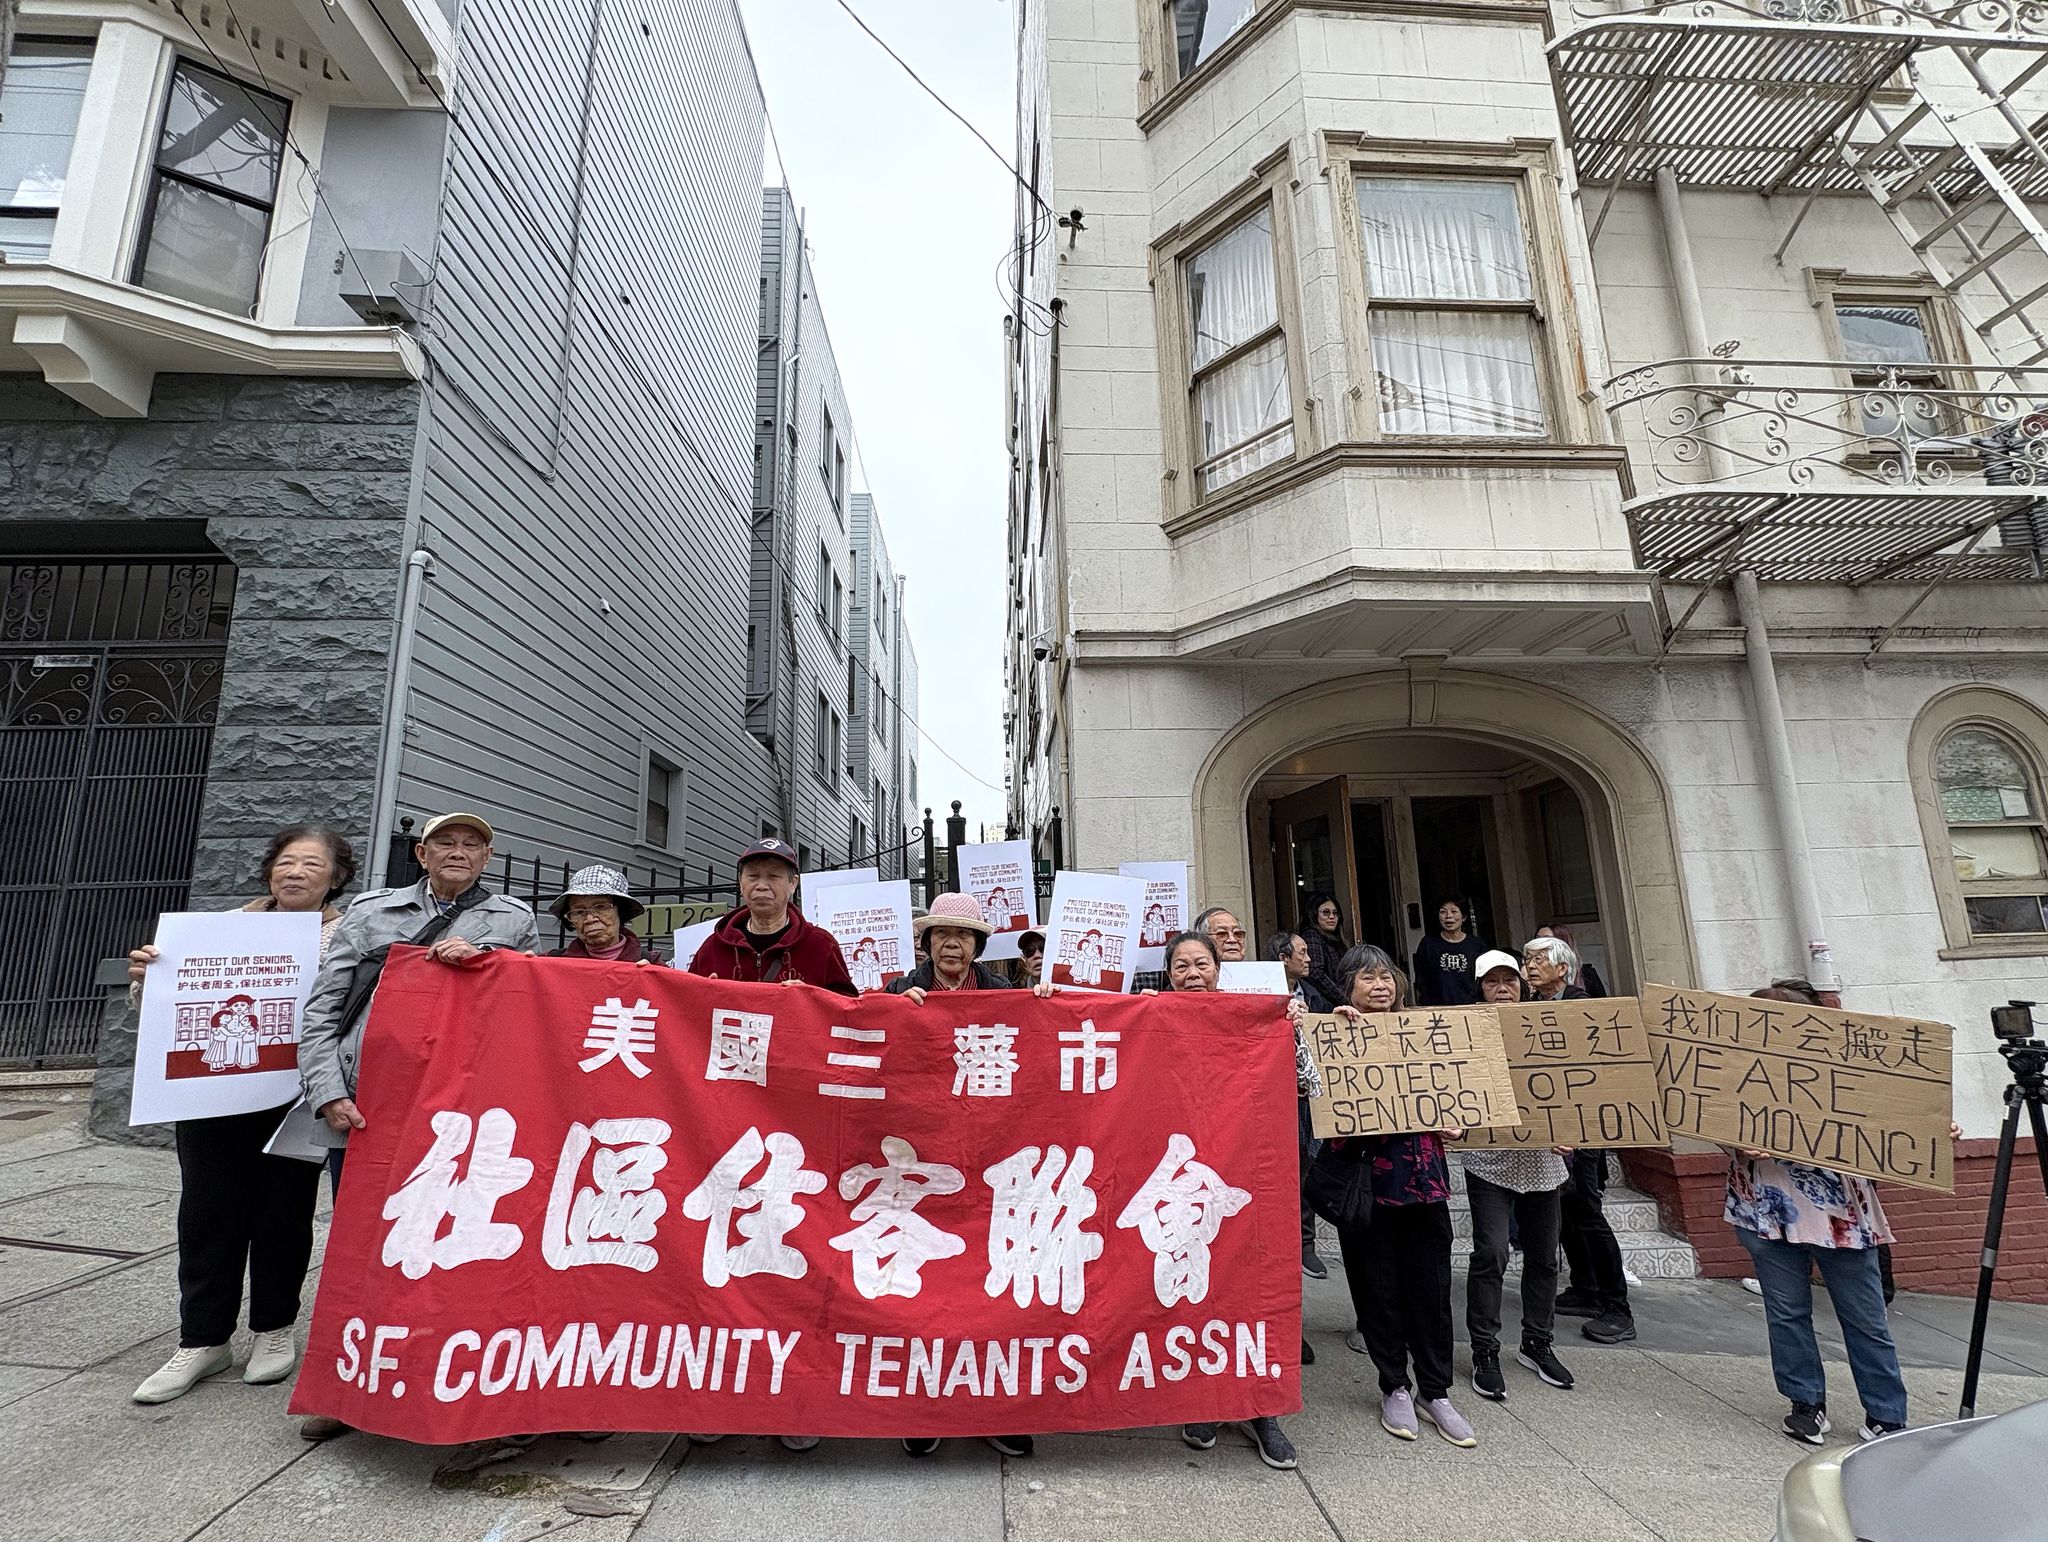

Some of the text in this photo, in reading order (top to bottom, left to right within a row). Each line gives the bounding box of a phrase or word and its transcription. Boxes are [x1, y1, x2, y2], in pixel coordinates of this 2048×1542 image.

[177, 965, 300, 978] PROTECT OUR COMMUNITY!
[184, 955, 295, 967] PROTECT OUR SENIORS.
[577, 997, 1121, 1099] 美國三藩市
[1311, 1013, 1473, 1062] 保护长者!
[1503, 1010, 1635, 1060] 逼迁
[1661, 992, 1943, 1075] 我们不会搬走
[1325, 1061, 1468, 1098] PROTECT
[1527, 1068, 1597, 1100] OP
[1656, 1043, 1868, 1118] WE ARE
[1332, 1090, 1492, 1135] SENIORS!
[1663, 1087, 1936, 1179] OT MOVING!
[381, 1107, 1253, 1316] 社區住客聯會
[336, 1317, 1282, 1402] S.F. COMMUNITY TENANTS ASSN.
